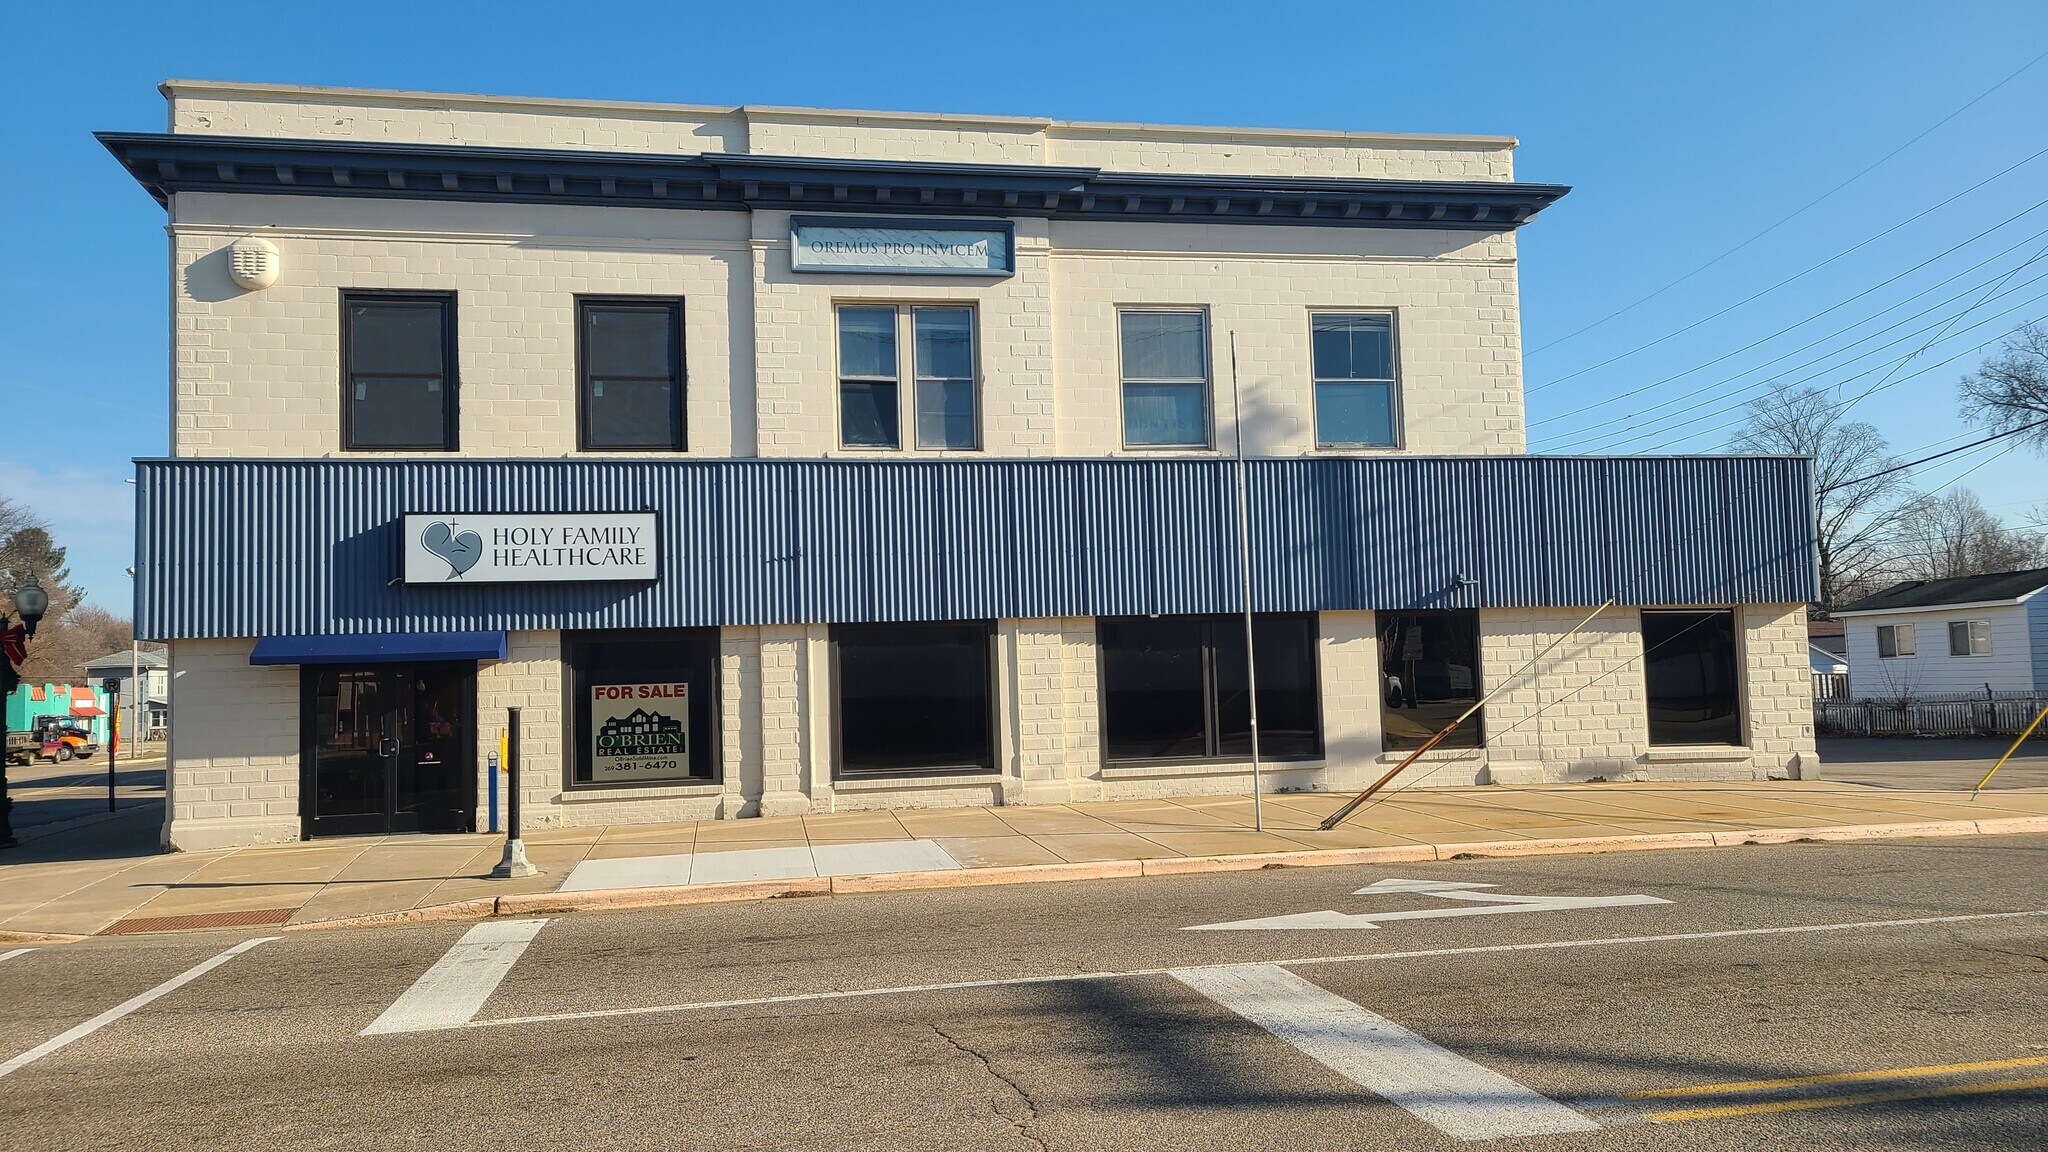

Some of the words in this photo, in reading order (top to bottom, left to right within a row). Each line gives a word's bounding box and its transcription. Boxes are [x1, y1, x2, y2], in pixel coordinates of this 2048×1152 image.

[811, 240, 878, 255] OREMUS
[883, 242, 915, 255] PRO
[921, 243, 988, 257] INVICEM
[493, 527, 554, 546] HOLY
[562, 526, 641, 545] FAMILY
[493, 547, 647, 567] HEALTHCARE
[595, 686, 633, 700] FOR
[638, 684, 685, 699] SALE
[599, 733, 682, 748] O'BRIEN
[598, 748, 629, 756] REAL
[636, 746, 678, 754] ESTATE
[615, 761, 677, 771] 381-6470
